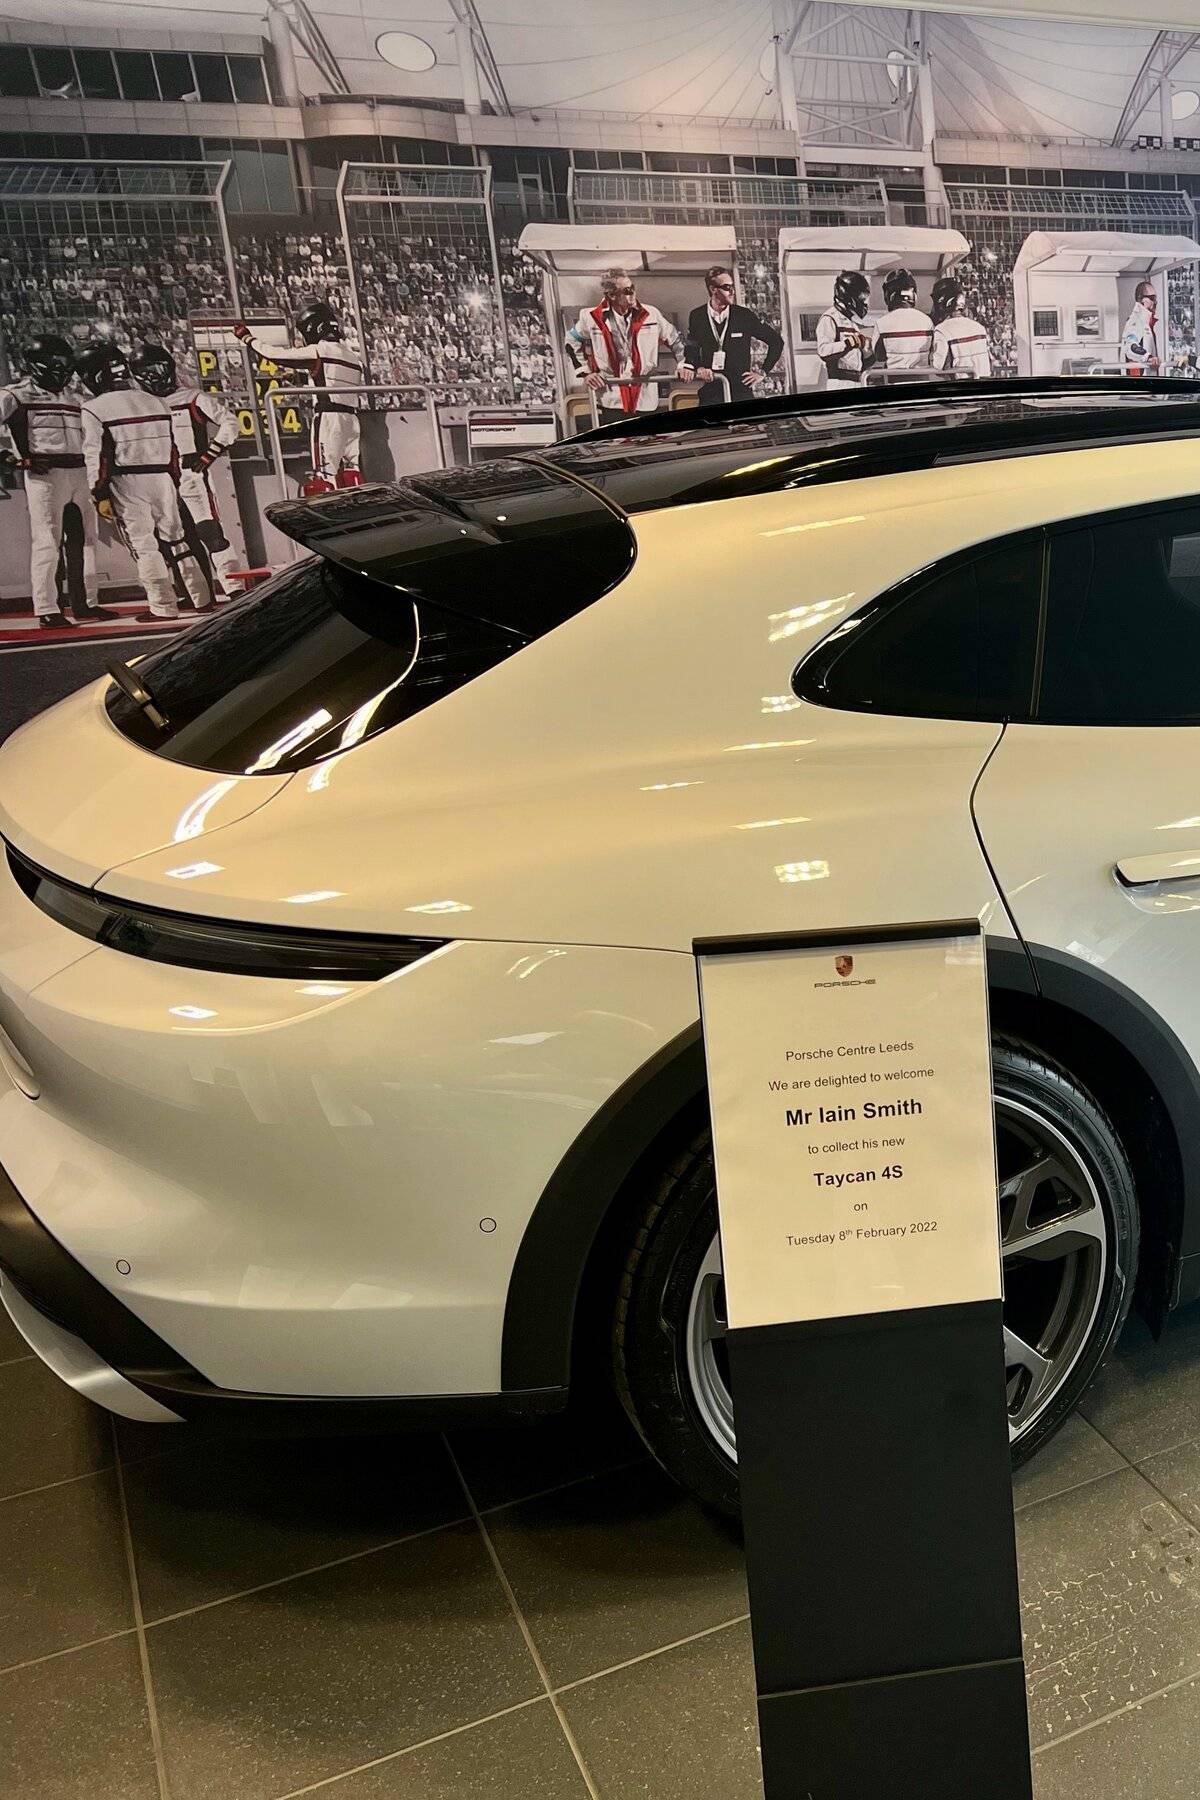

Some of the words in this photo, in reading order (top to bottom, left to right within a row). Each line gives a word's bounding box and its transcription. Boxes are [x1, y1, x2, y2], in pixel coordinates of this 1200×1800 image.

[814, 978, 876, 989] PORSCHE
[785, 1048, 834, 1062] Porsche
[836, 1045, 876, 1058] Centre
[879, 1040, 914, 1054] Leeds
[767, 1080, 789, 1092] We
[791, 1080, 811, 1090] are
[813, 1073, 867, 1089] delighted
[869, 1072, 882, 1083] to
[883, 1067, 935, 1082] welcome
[785, 1108, 813, 1127] Mr
[818, 1104, 857, 1124] Iain
[862, 1098, 923, 1120] Smith
[807, 1144, 820, 1155] to
[821, 1139, 860, 1153] collect
[861, 1138, 879, 1149] his
[881, 1137, 906, 1148] new
[812, 1170, 877, 1189] Taycan
[881, 1164, 904, 1180] 4S
[853, 1202, 868, 1212] on
[785, 1232, 836, 1247] Tuesday
[838, 1228, 853, 1241] 8th
[856, 1225, 907, 1240] February
[909, 1220, 938, 1234] 2022
